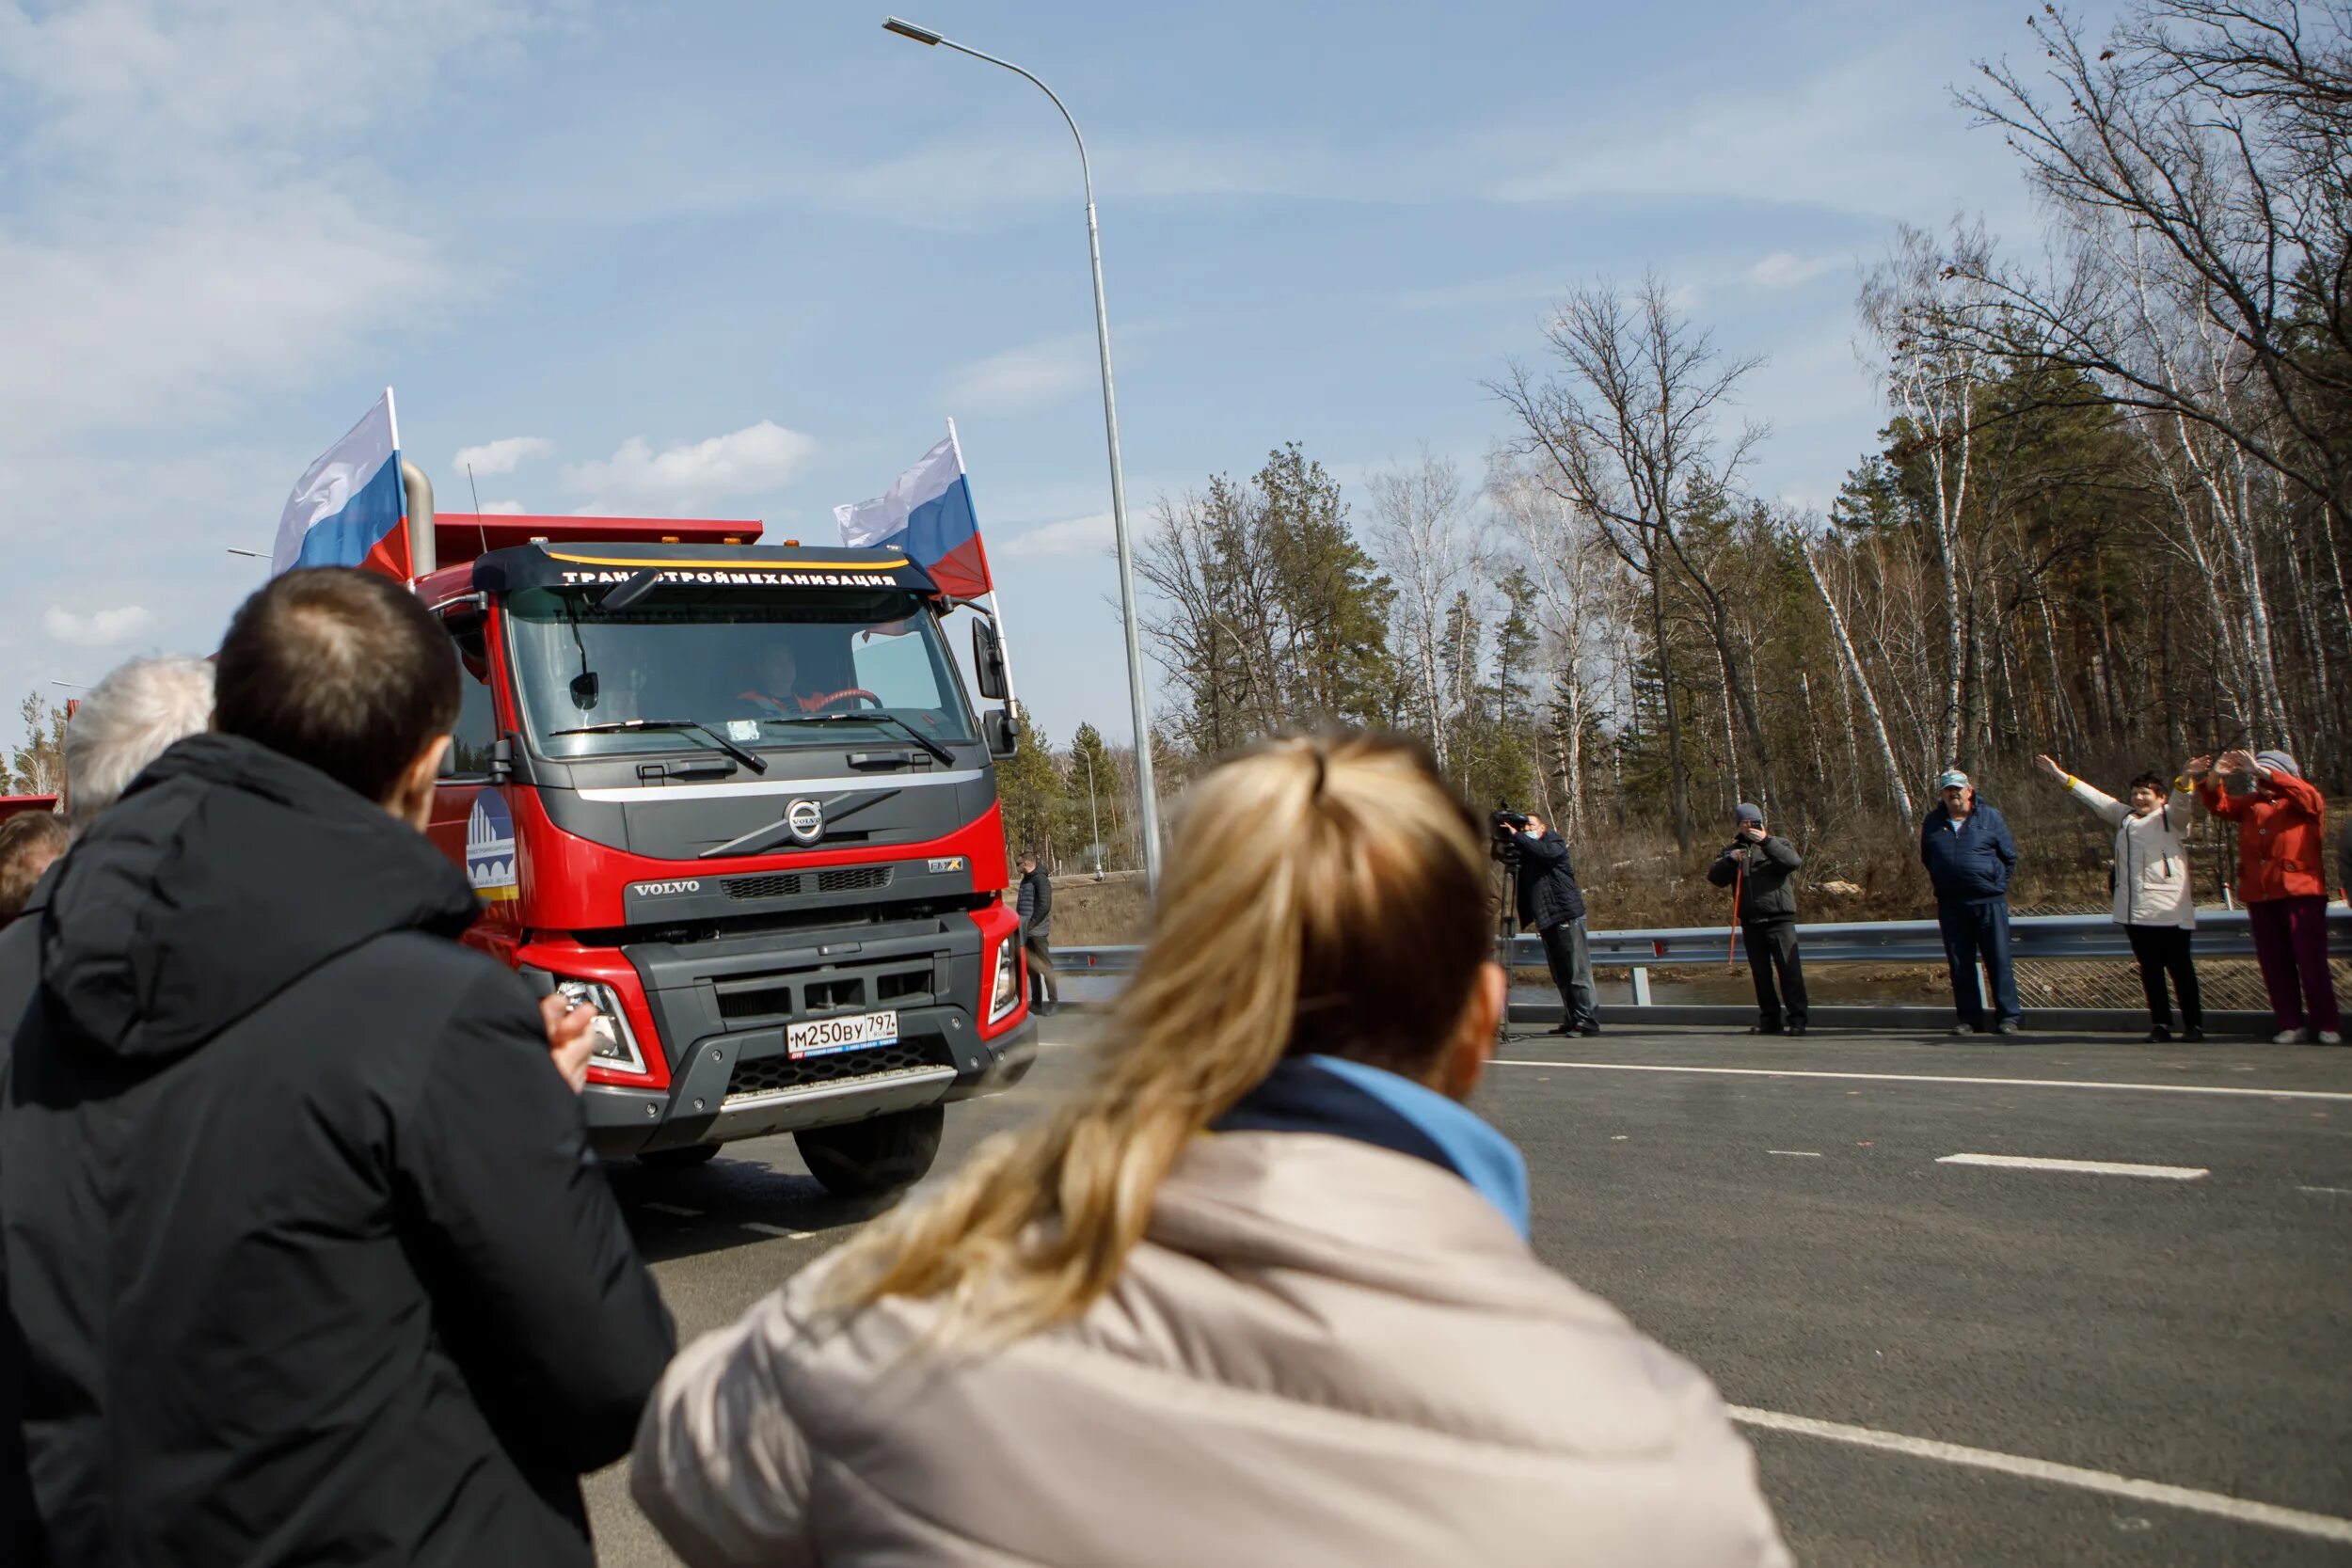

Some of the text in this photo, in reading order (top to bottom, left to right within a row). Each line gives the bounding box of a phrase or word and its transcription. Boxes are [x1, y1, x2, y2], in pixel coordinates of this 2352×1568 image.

[930, 859, 962, 871] FMX
[633, 880, 700, 896] VOLVO
[795, 1014, 891, 1048] М250ВУ 797
